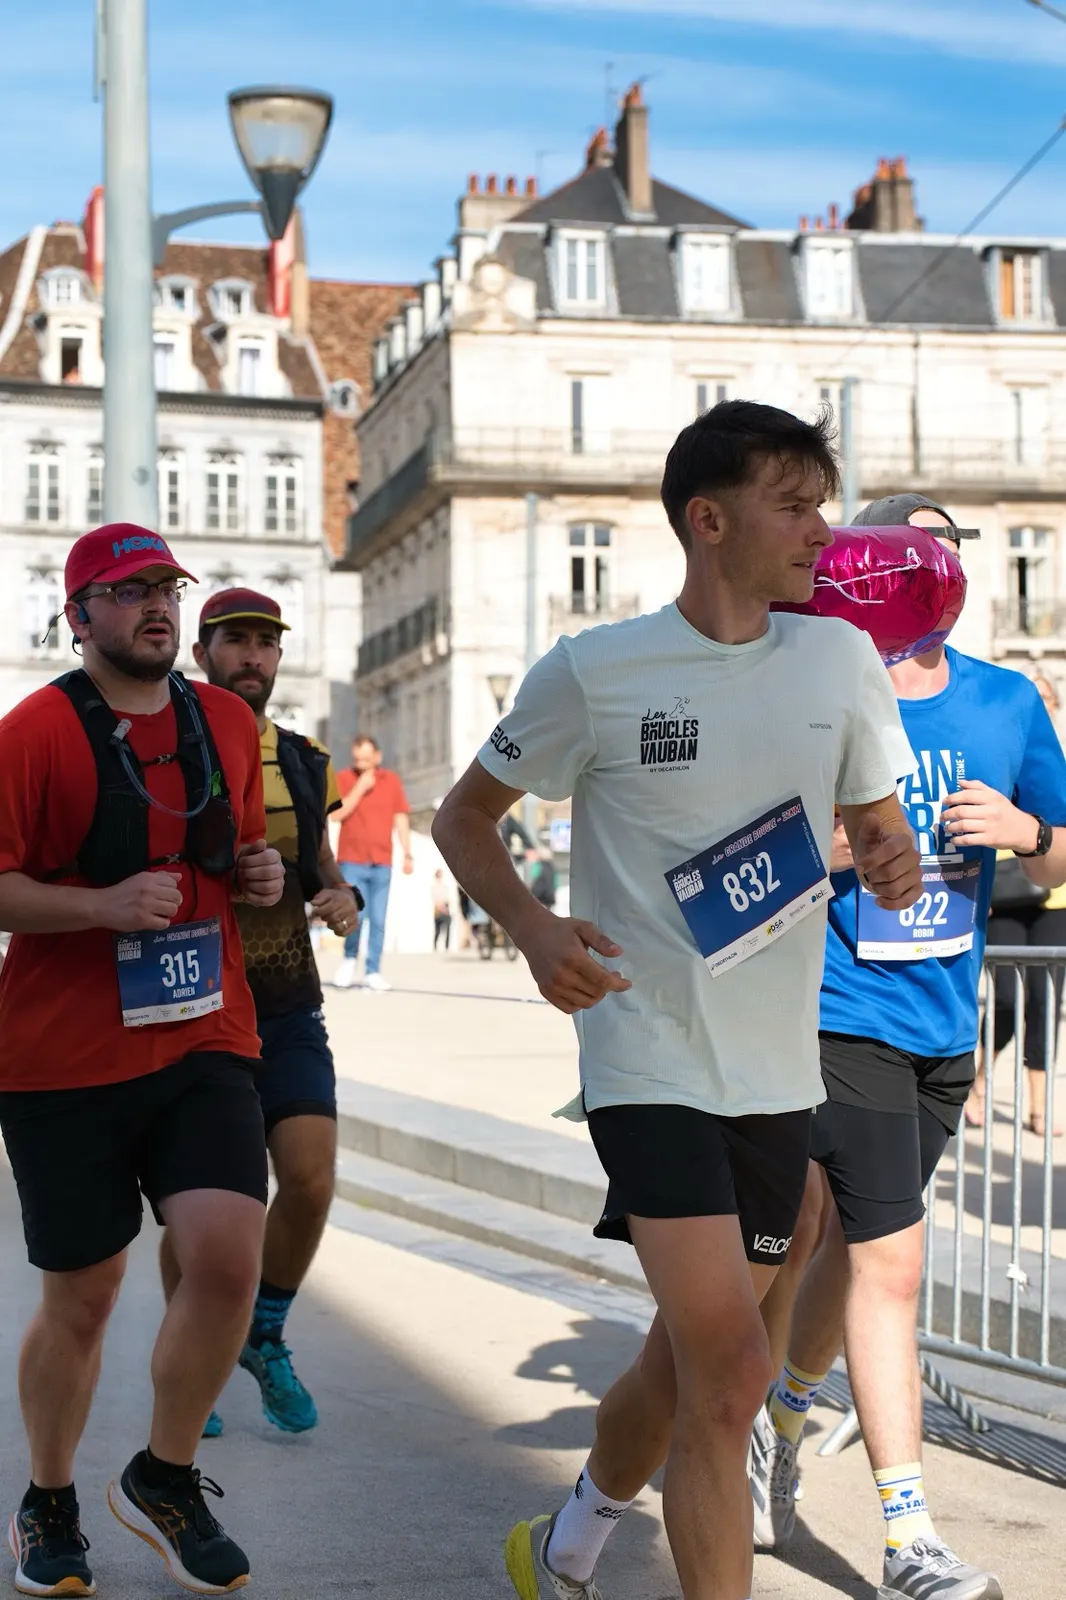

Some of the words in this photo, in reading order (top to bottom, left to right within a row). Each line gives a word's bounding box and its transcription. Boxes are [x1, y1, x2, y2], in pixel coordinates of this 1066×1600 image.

[113, 536, 168, 558] HOKA
[641, 708, 667, 721] Les
[641, 719, 699, 742] BOUCLES
[640, 738, 698, 765] VAUBAN
[724, 833, 754, 857] GRANDE
[676, 879, 705, 902] VAUBAN
[721, 851, 781, 912] 832
[912, 928, 935, 938] ROBIN
[160, 949, 200, 987] 315
[173, 986, 195, 999] ADRIEN
